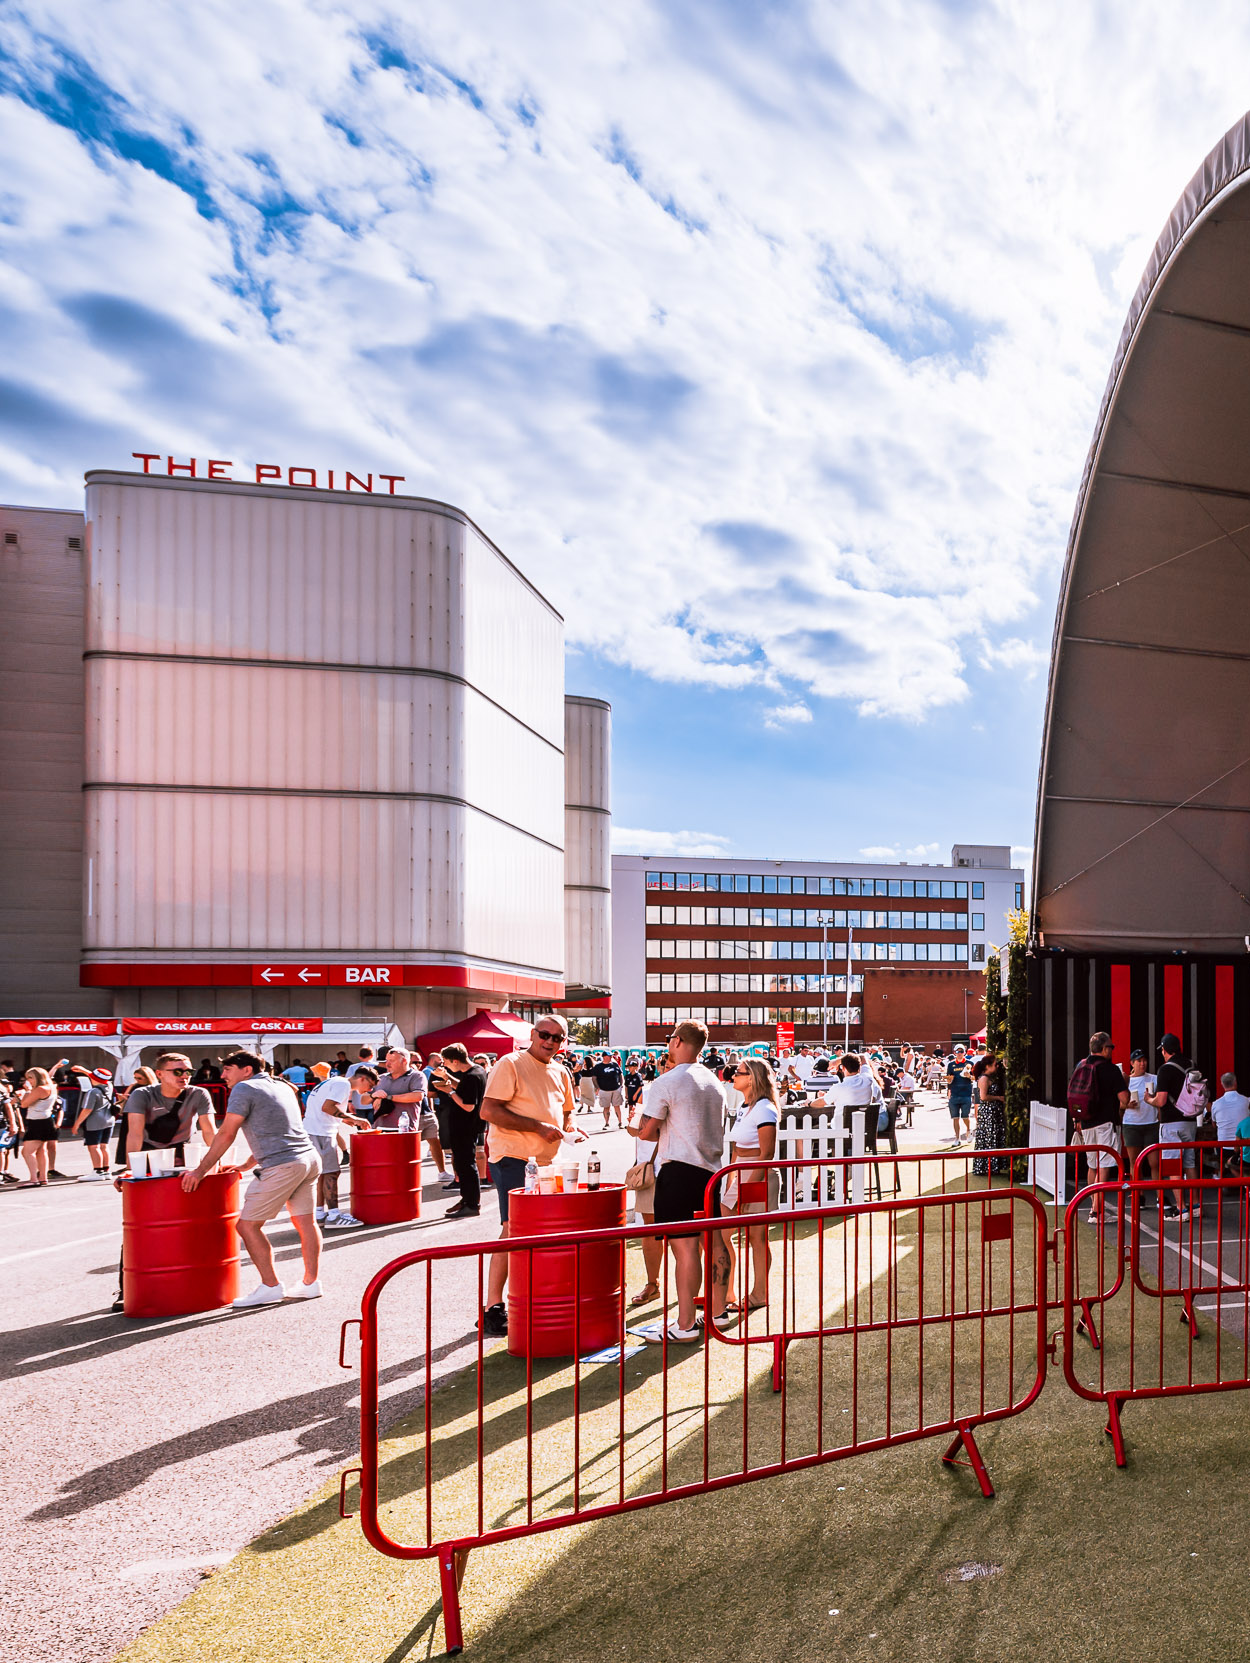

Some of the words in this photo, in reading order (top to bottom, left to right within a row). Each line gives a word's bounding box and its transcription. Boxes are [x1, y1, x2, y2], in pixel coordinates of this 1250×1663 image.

[132, 452, 233, 481] THE
[255, 463, 406, 496] POINT
[346, 967, 391, 983] BAR
[37, 1023, 72, 1032] CASK
[74, 1023, 98, 1032] ALE
[155, 1022, 188, 1031] CASK
[189, 1022, 213, 1031] ALE
[251, 1022, 282, 1030] CASK
[283, 1022, 305, 1030] ALE
